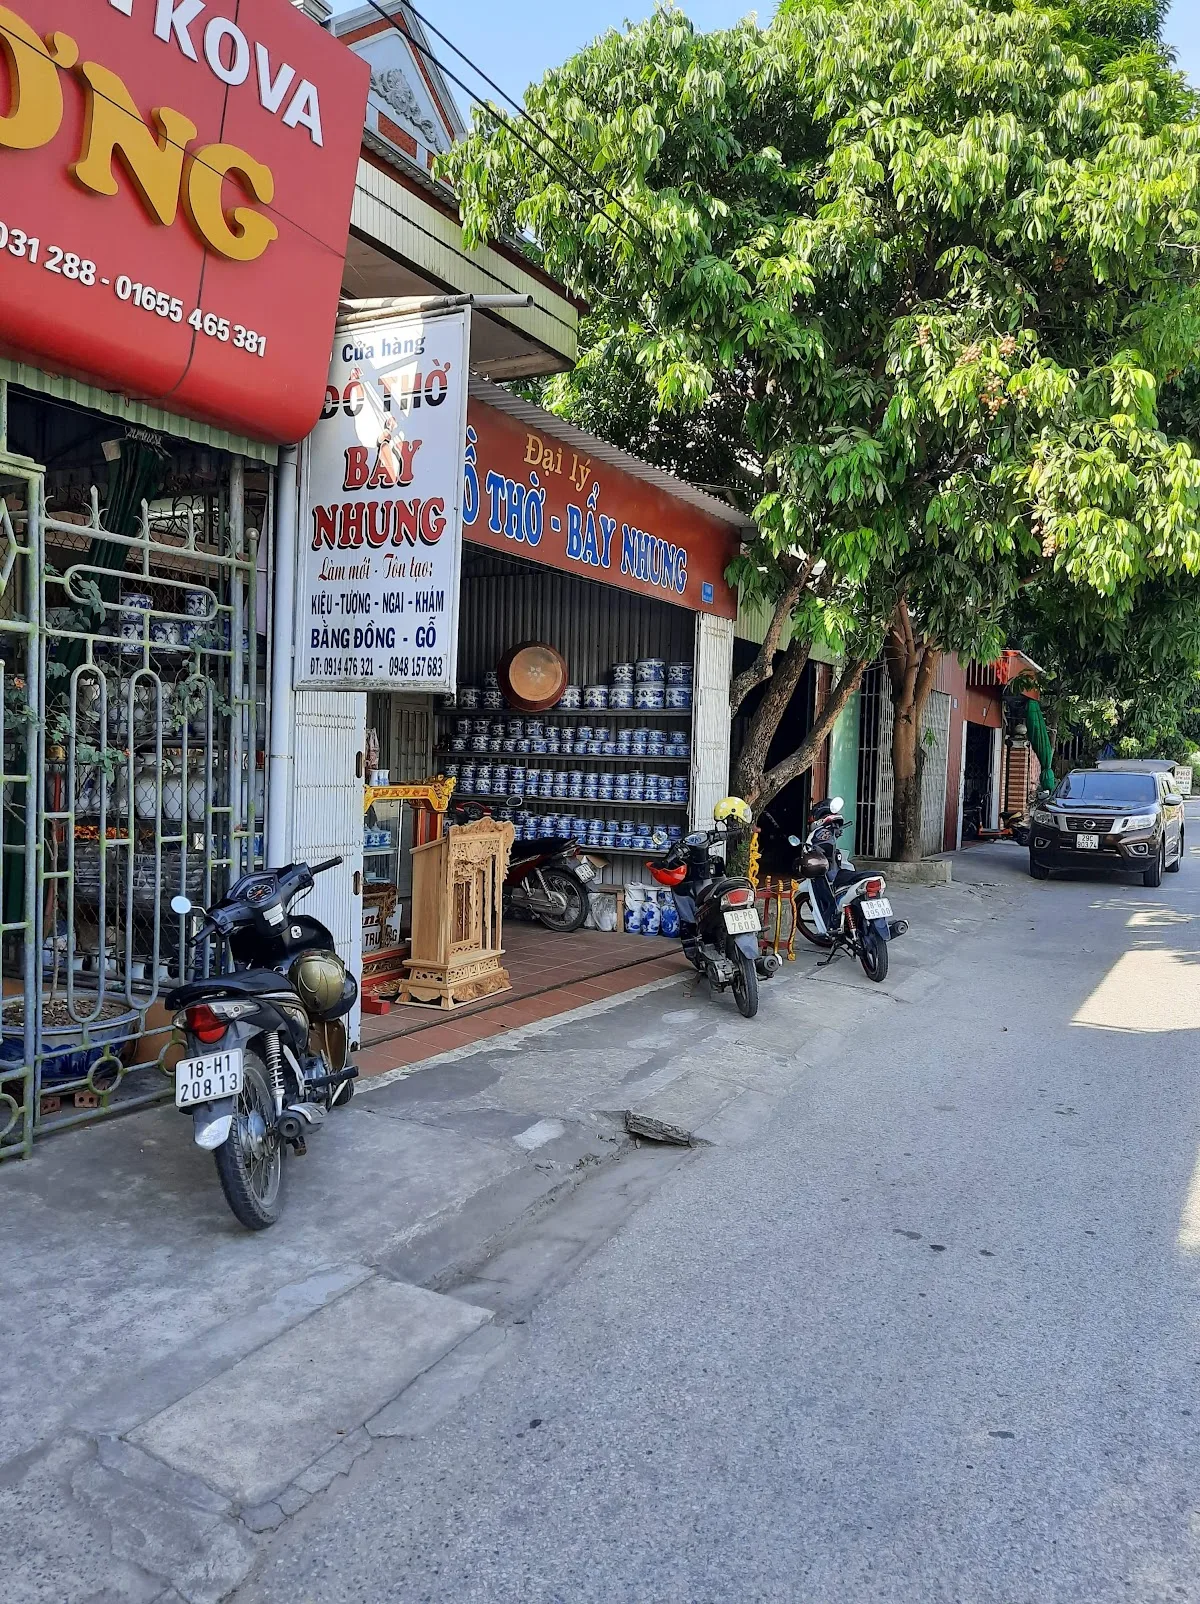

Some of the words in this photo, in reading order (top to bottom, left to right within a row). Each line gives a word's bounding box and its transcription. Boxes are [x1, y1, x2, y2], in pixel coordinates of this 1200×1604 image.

[154, 0, 324, 147] KOVA
[44, 245, 97, 286] 288
[116, 275, 184, 323] 01655
[188, 308, 230, 343] 465
[232, 325, 268, 358] 381
[381, 336, 426, 360] hàng
[378, 358, 451, 413] THỜ
[523, 433, 563, 477] Đại
[568, 453, 592, 492] lý
[311, 497, 447, 551] NHUNG
[485, 469, 547, 547] THỜ
[620, 522, 688, 595] NHUNG
[318, 556, 345, 581] Làm
[383, 553, 406, 579] Tôn
[382, 591, 405, 614] NGAI
[415, 585, 445, 613] KHÁM
[354, 620, 396, 649] ĐỒNG
[415, 616, 437, 649] GỖ
[310, 657, 322, 675] ĐT:
[324, 656, 342, 675] 0914
[344, 657, 358, 675] 476
[360, 657, 374, 676] 321
[389, 656, 409, 676] 0948
[411, 656, 426, 676] 157
[427, 656, 443, 676] 683
[730, 910, 754, 922] 18-P6
[732, 920, 756, 932] 7606
[188, 1055, 230, 1080] 18-H1
[181, 1073, 238, 1102] 208.13
